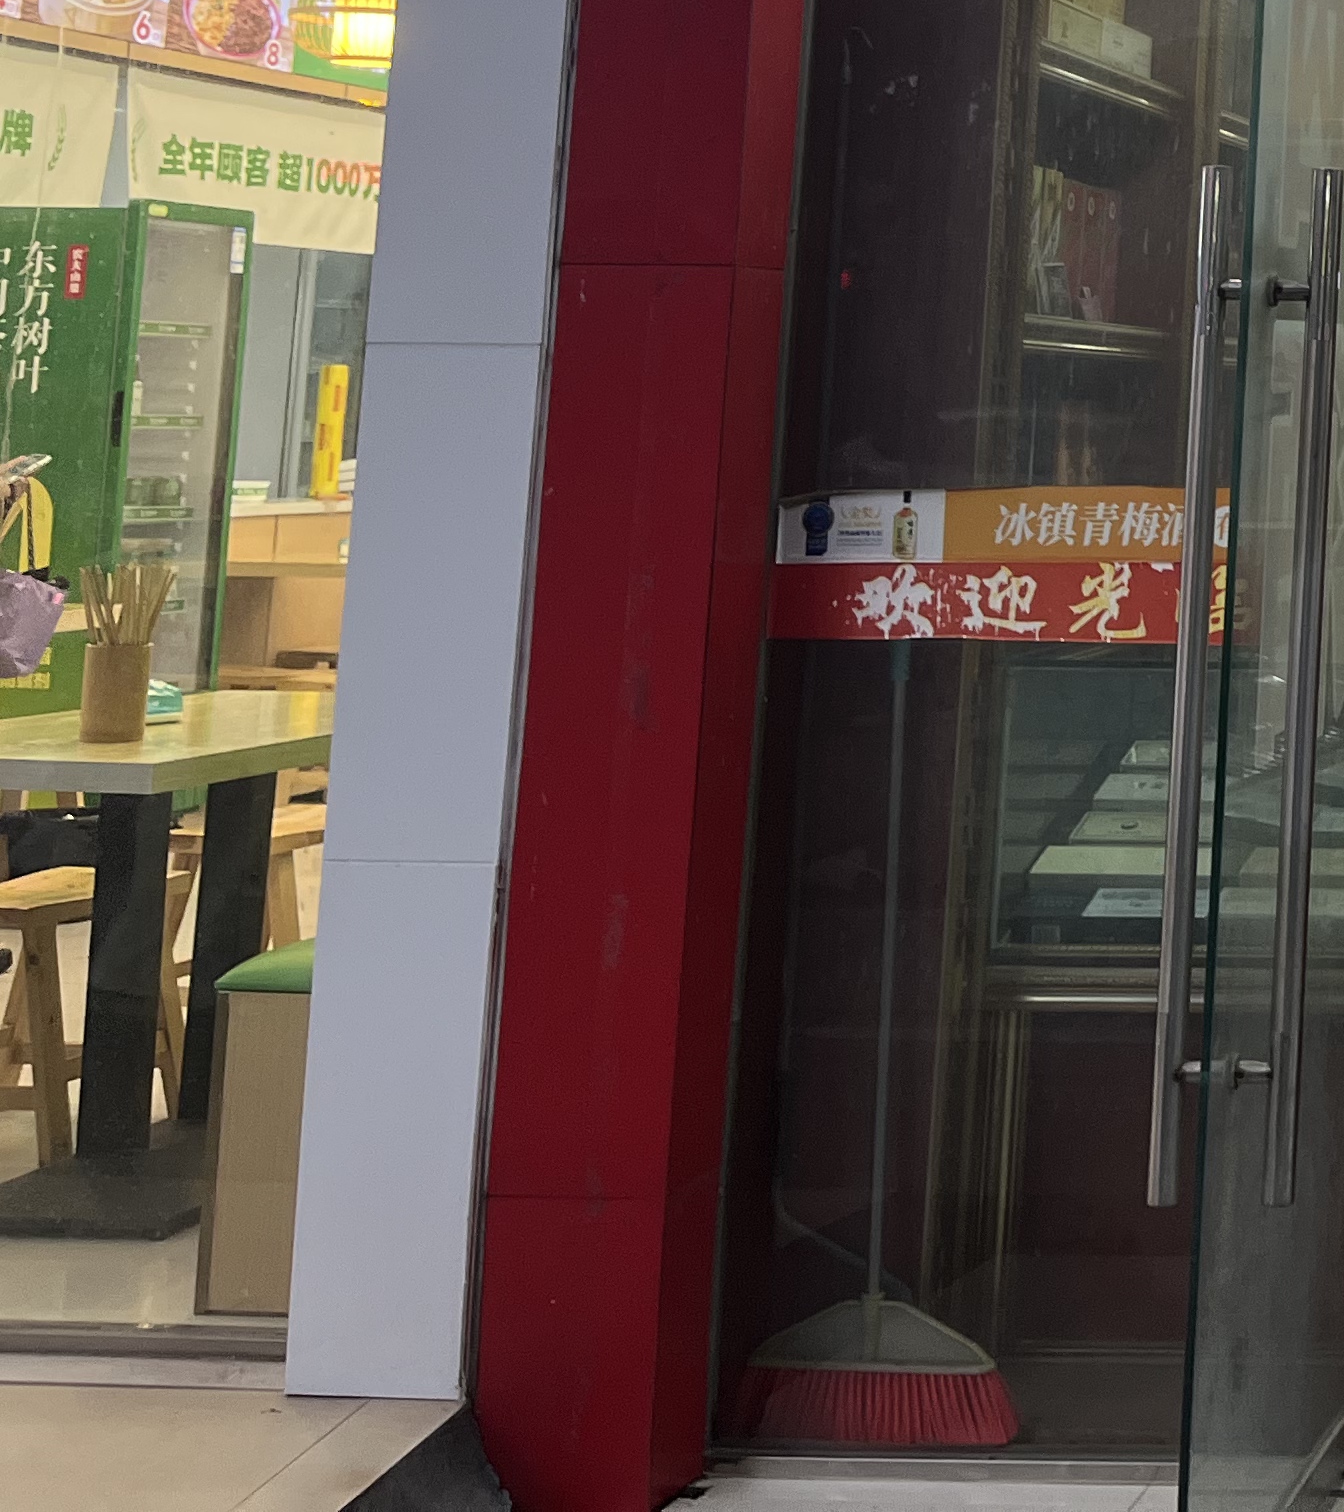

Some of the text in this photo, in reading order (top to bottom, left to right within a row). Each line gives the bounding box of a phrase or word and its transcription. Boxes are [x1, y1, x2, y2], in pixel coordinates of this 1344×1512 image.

[135, 13, 151, 41] 6
[266, 43, 280, 67] 8
[158, 134, 270, 188] 全年顾客
[10, 240, 58, 394] 东方树叶
